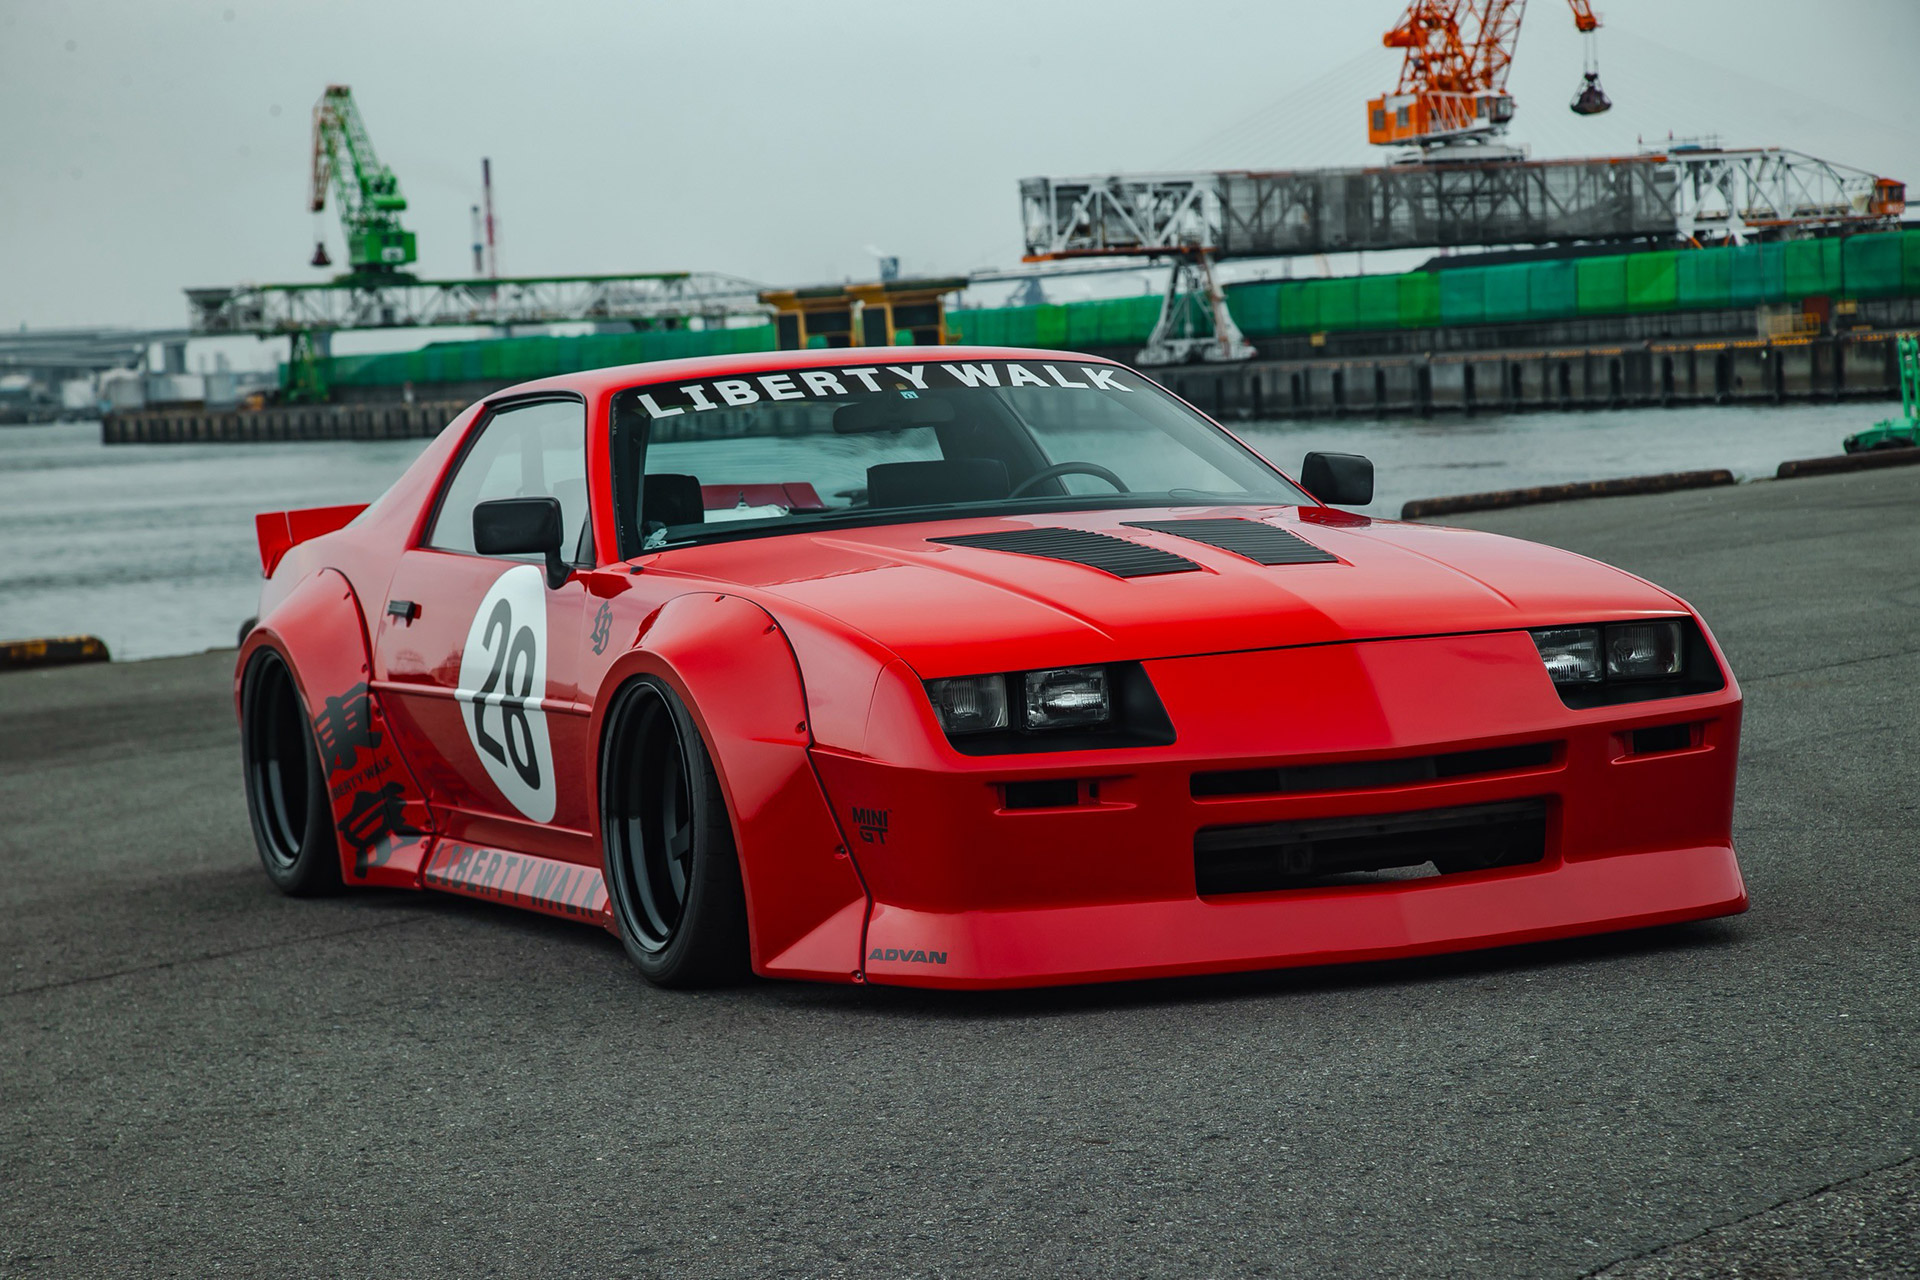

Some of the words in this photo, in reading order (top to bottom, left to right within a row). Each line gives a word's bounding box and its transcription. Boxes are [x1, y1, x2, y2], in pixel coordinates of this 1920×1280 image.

[637, 365, 929, 419] LIBERTY
[940, 363, 1134, 393] WALK
[465, 598, 541, 790] 28
[330, 772, 363, 799] BERTY
[852, 806, 888, 827] MINI
[859, 825, 888, 844] GT
[425, 842, 536, 901] LIBERTY
[530, 863, 603, 917] WALK
[868, 948, 948, 965] ADVAN
